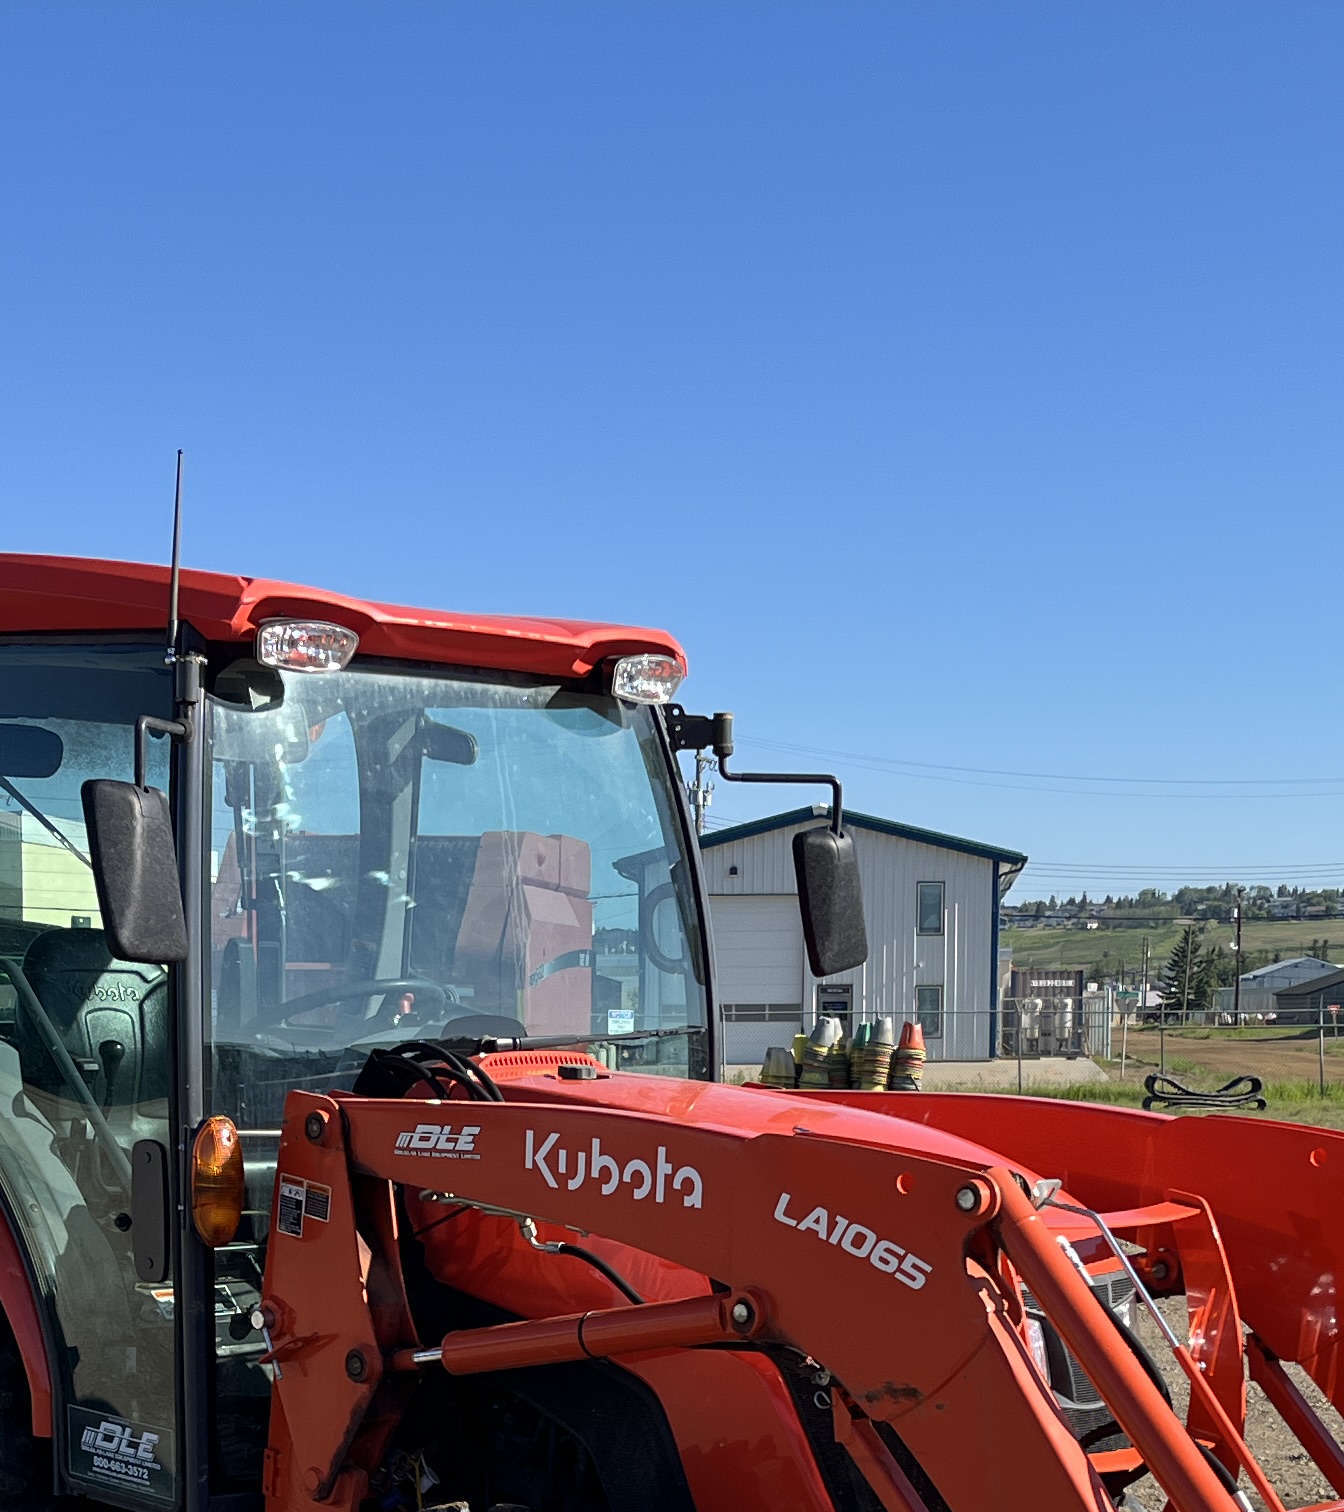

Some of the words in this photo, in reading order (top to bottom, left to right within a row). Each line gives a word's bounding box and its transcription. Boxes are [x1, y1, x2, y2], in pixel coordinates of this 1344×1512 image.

[408, 1124, 481, 1152] DLE
[524, 1129, 703, 1209] Kubota
[773, 1192, 934, 1291] LA1065
[94, 1421, 160, 1462] DLE
